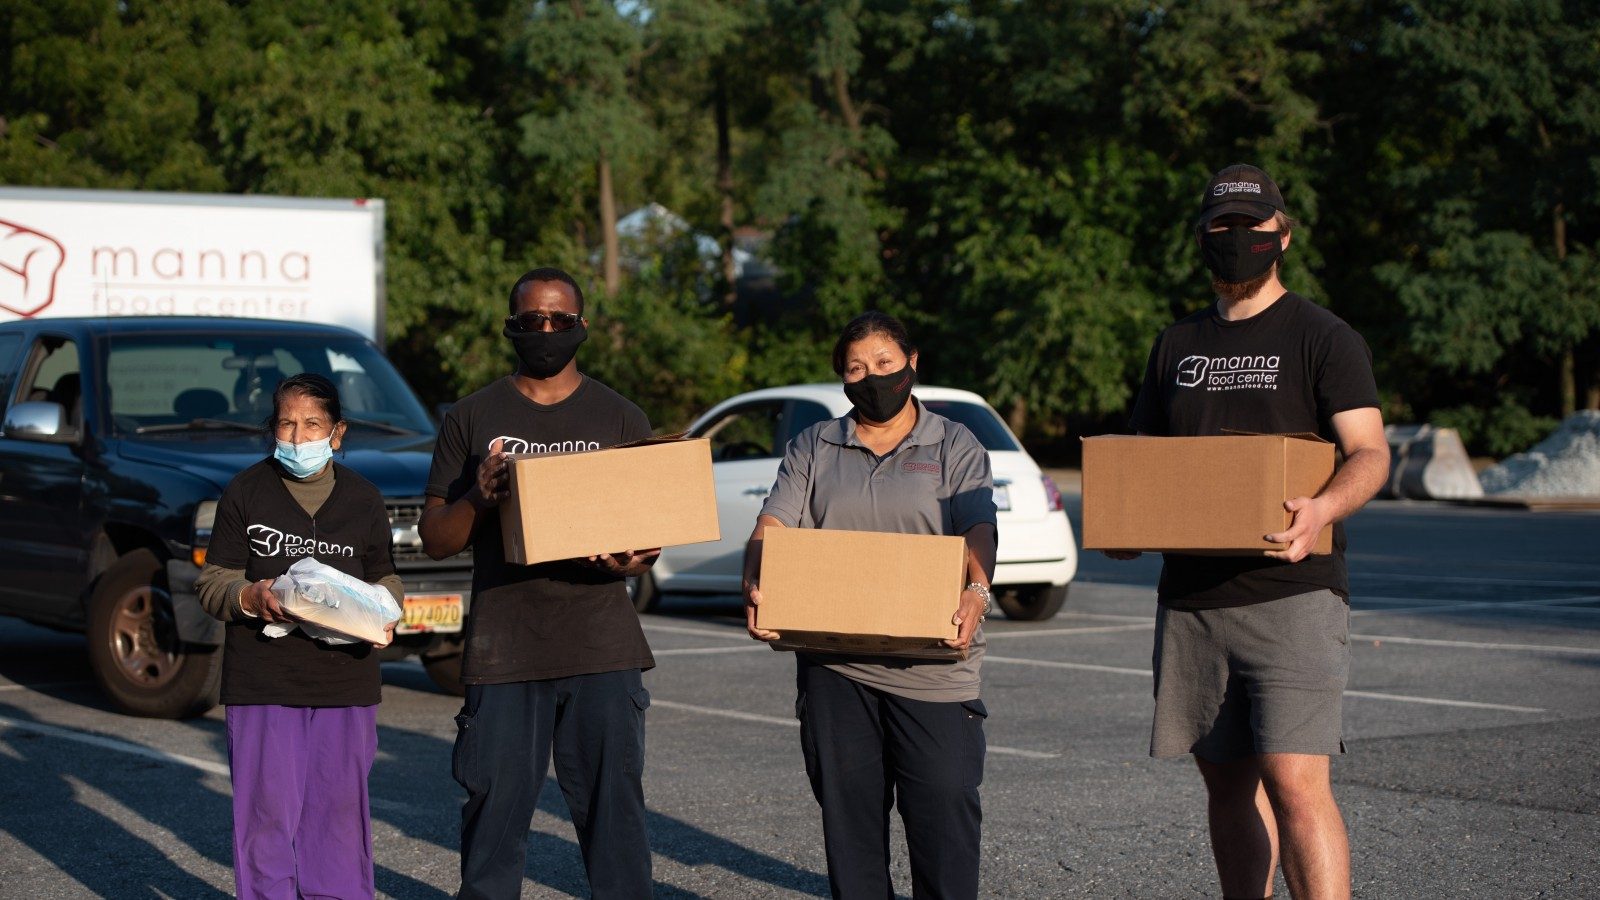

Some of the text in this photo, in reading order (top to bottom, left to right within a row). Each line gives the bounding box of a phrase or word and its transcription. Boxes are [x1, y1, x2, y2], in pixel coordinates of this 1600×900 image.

[91, 246, 310, 281] manna
[94, 292, 309, 317] food center
[1210, 356, 1280, 369] manna
[1208, 372, 1278, 385] food center
[530, 440, 600, 453] manna
